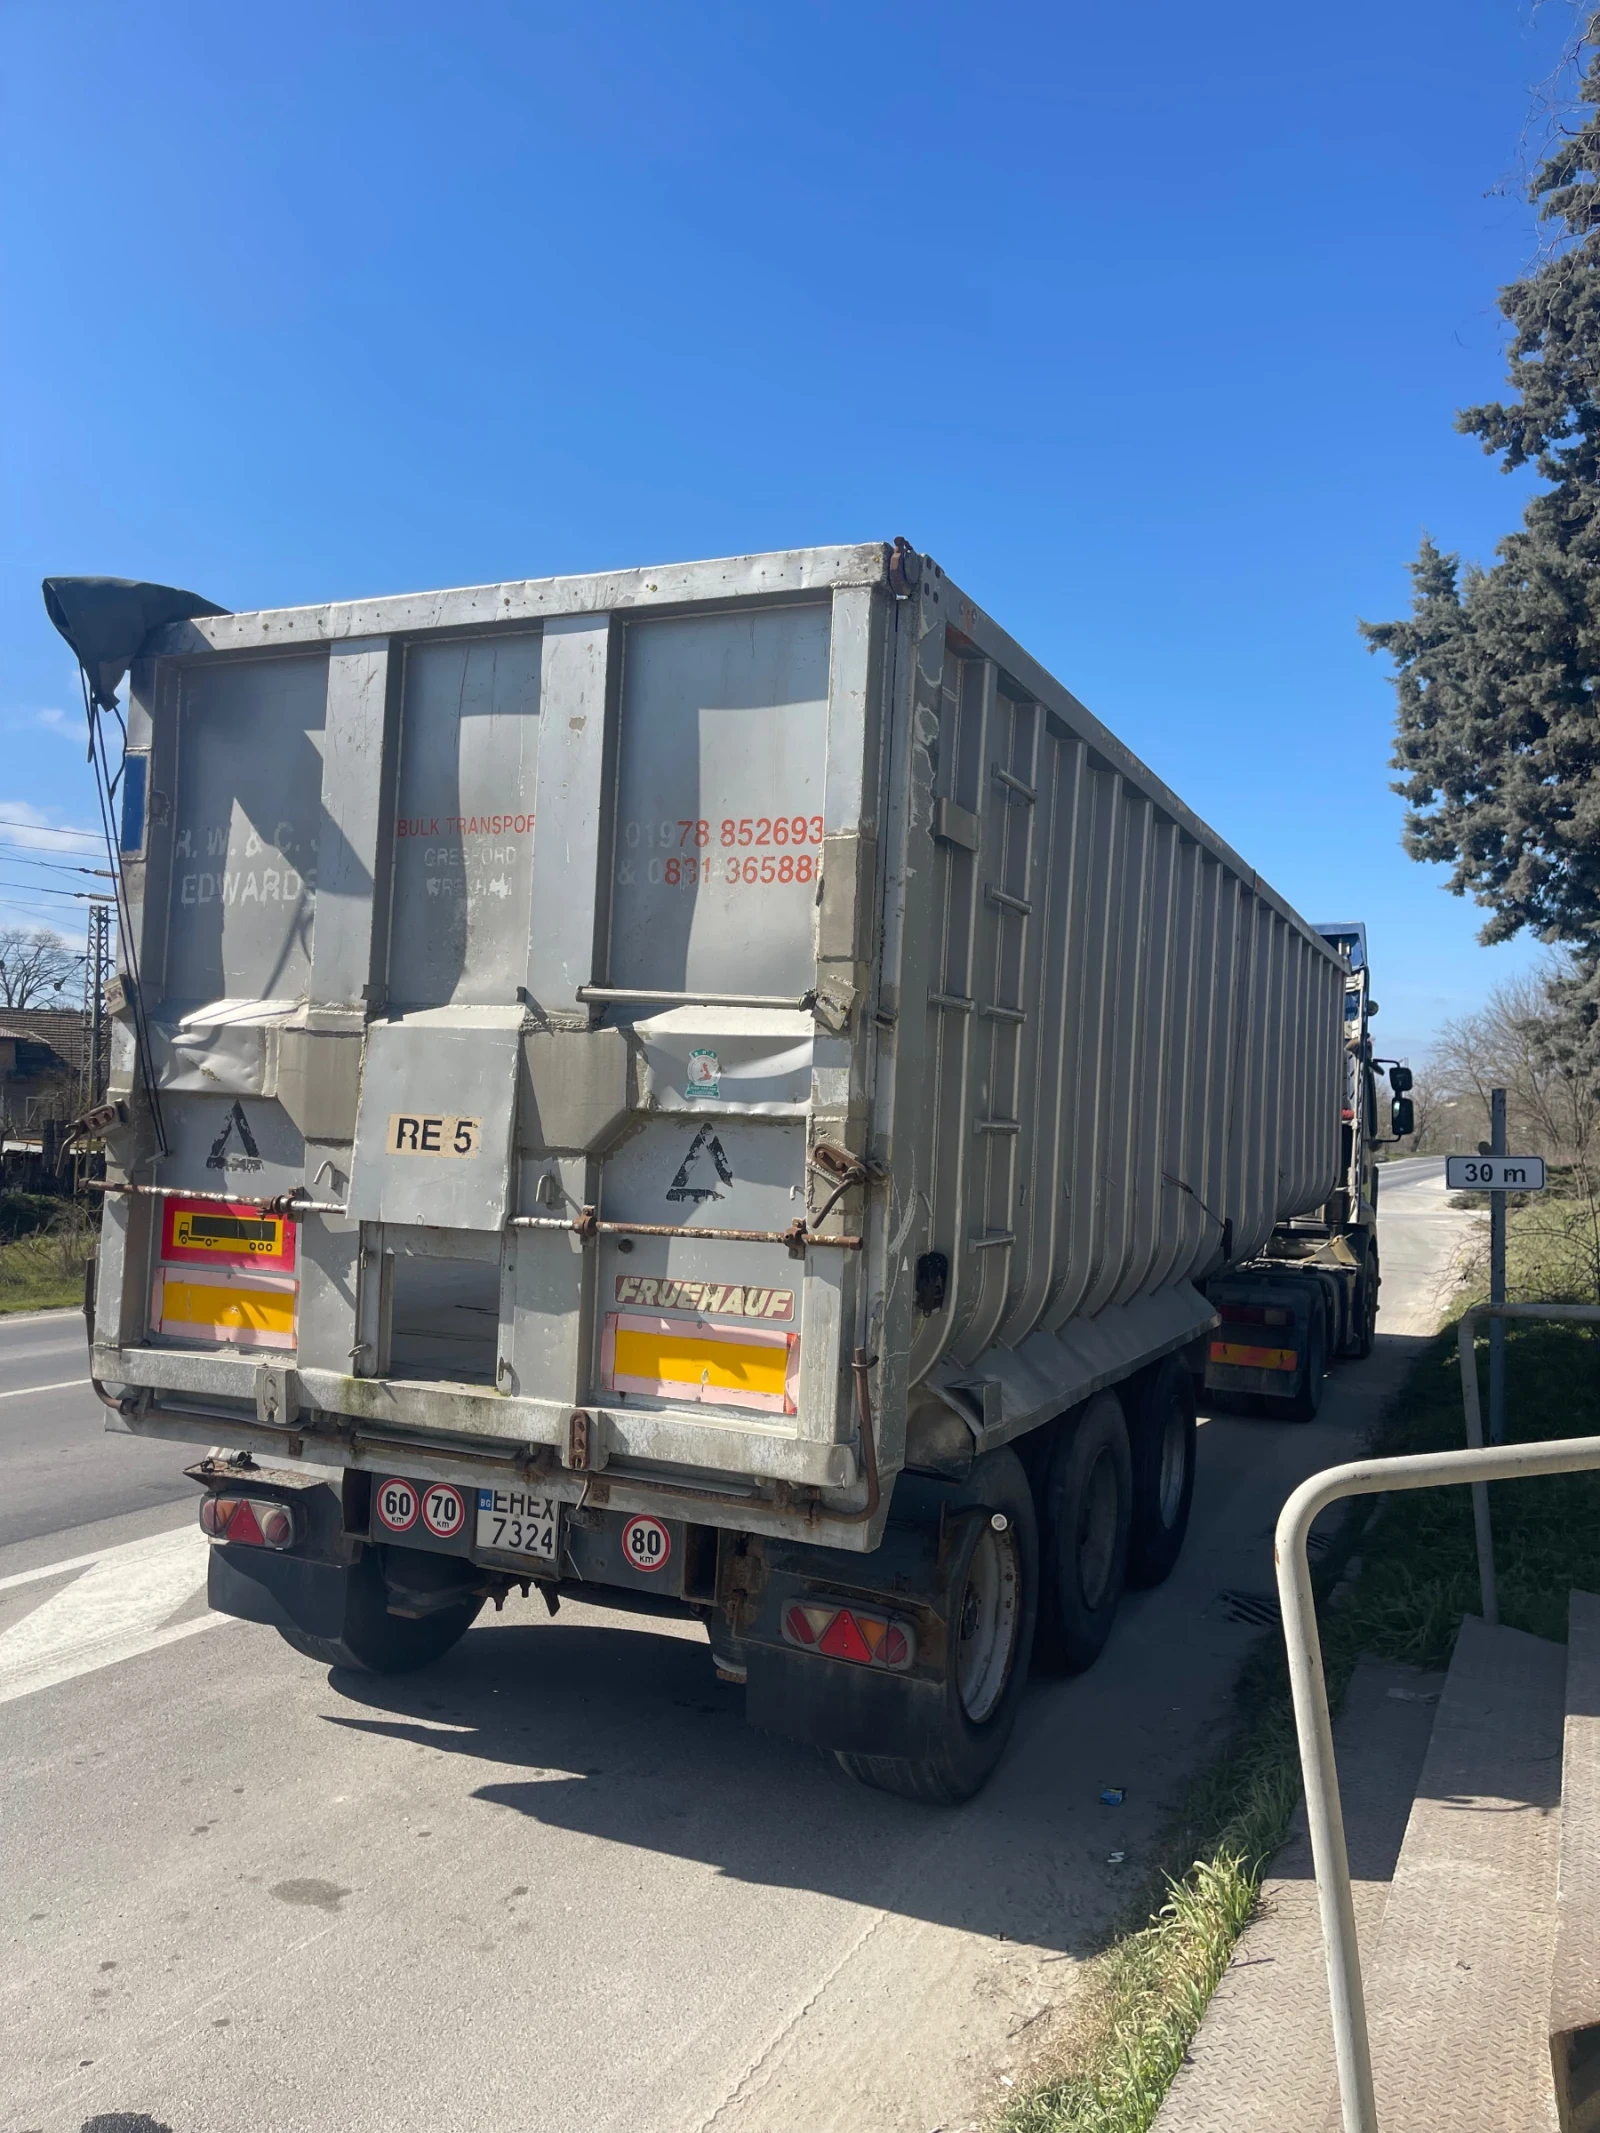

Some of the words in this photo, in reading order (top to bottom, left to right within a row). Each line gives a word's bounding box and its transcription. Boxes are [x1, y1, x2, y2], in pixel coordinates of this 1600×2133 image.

[397, 819, 440, 837] BULK
[625, 819, 710, 848] 01978
[719, 816, 823, 847] 852693
[396, 1117, 441, 1151] RE
[453, 1121, 474, 1153] 5
[1465, 1163, 1493, 1182] 30
[1504, 1168, 1526, 1182] m
[616, 1277, 792, 1317] FRUEHAUF
[386, 1490, 410, 1516] 60
[431, 1494, 456, 1521] 70
[480, 1498, 491, 1508] BG
[492, 1517, 553, 1555] 7324
[632, 1528, 661, 1556] 80
